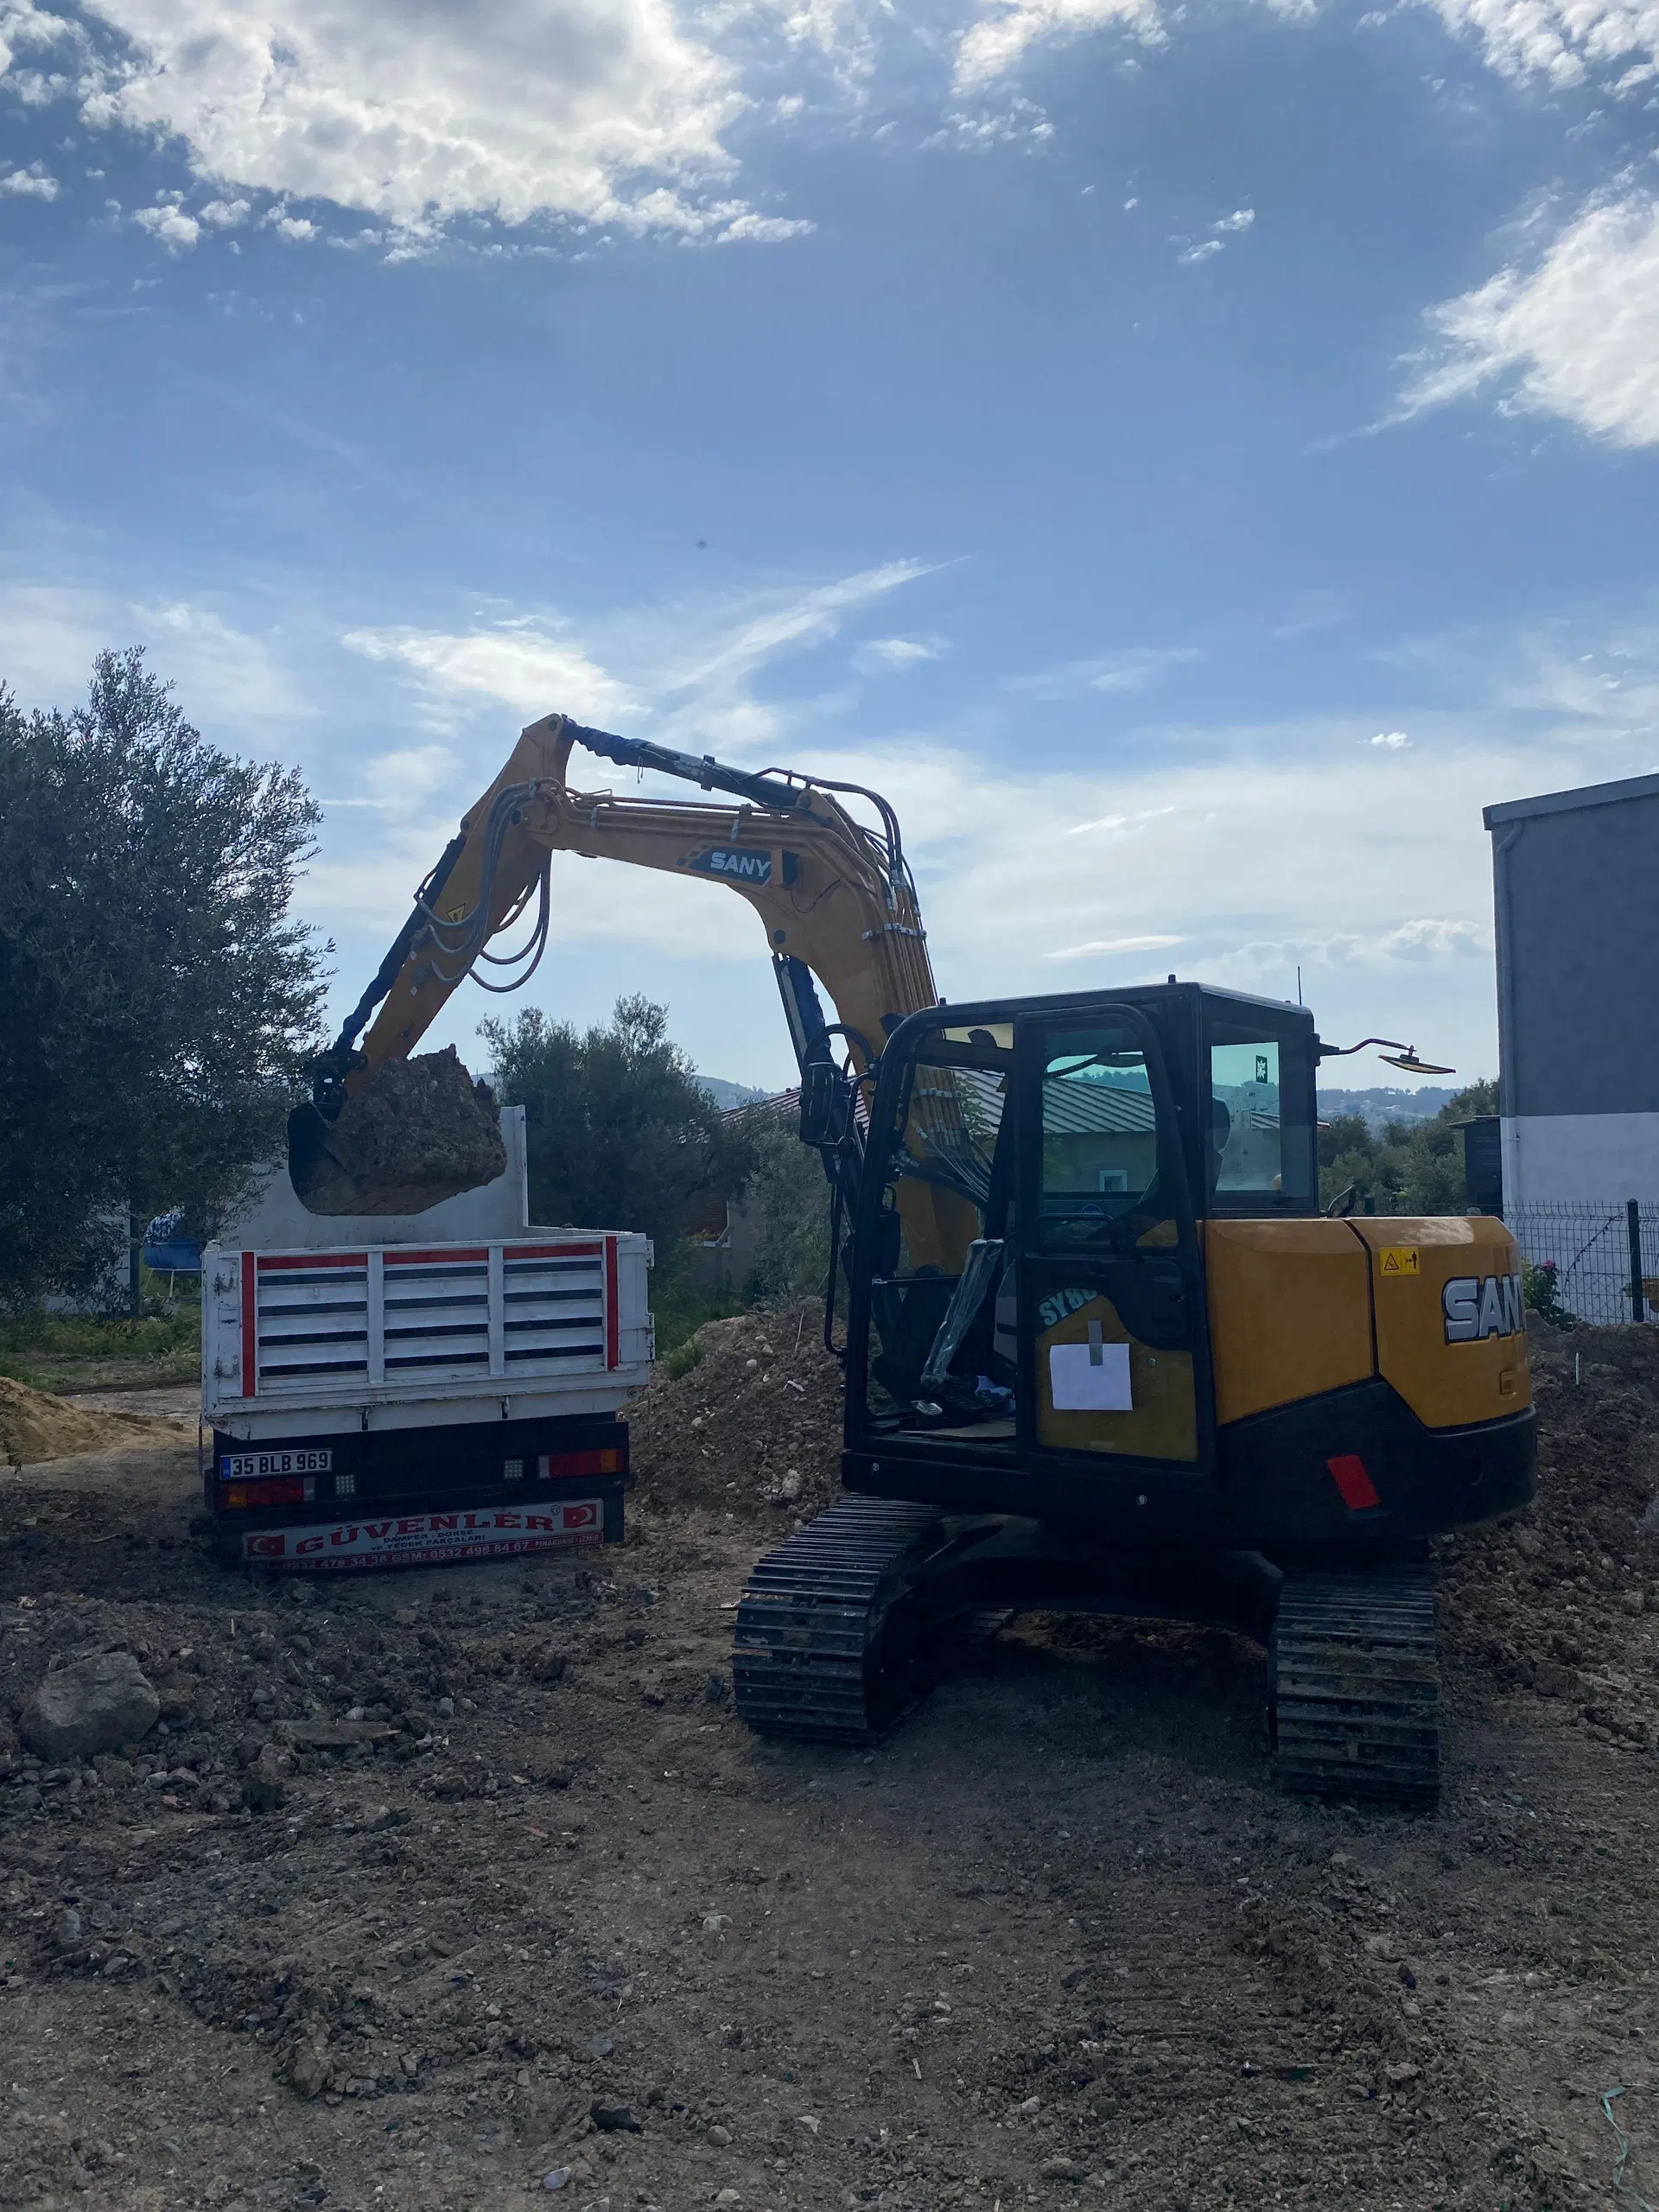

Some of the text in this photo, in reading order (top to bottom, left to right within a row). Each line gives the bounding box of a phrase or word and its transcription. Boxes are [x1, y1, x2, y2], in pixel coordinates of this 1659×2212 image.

[710, 851, 771, 877] SANY
[232, 1452, 327, 1475] 35 BLB 969
[296, 1513, 554, 1554] GÜVENLER
[384, 1533, 428, 1543] DAMPER
[437, 1529, 474, 1538] DORSE
[387, 1541, 423, 1549] YEDEK
[426, 1535, 486, 1546] PARÇALARI
[321, 1558, 346, 1568] 478
[351, 1557, 366, 1566] 34
[373, 1555, 387, 1565] 36
[391, 1552, 427, 1563] GSM:
[430, 1548, 462, 1560] 0532
[466, 1545, 490, 1555] 498
[494, 1543, 510, 1553] 84
[515, 1541, 529, 1551] 67
